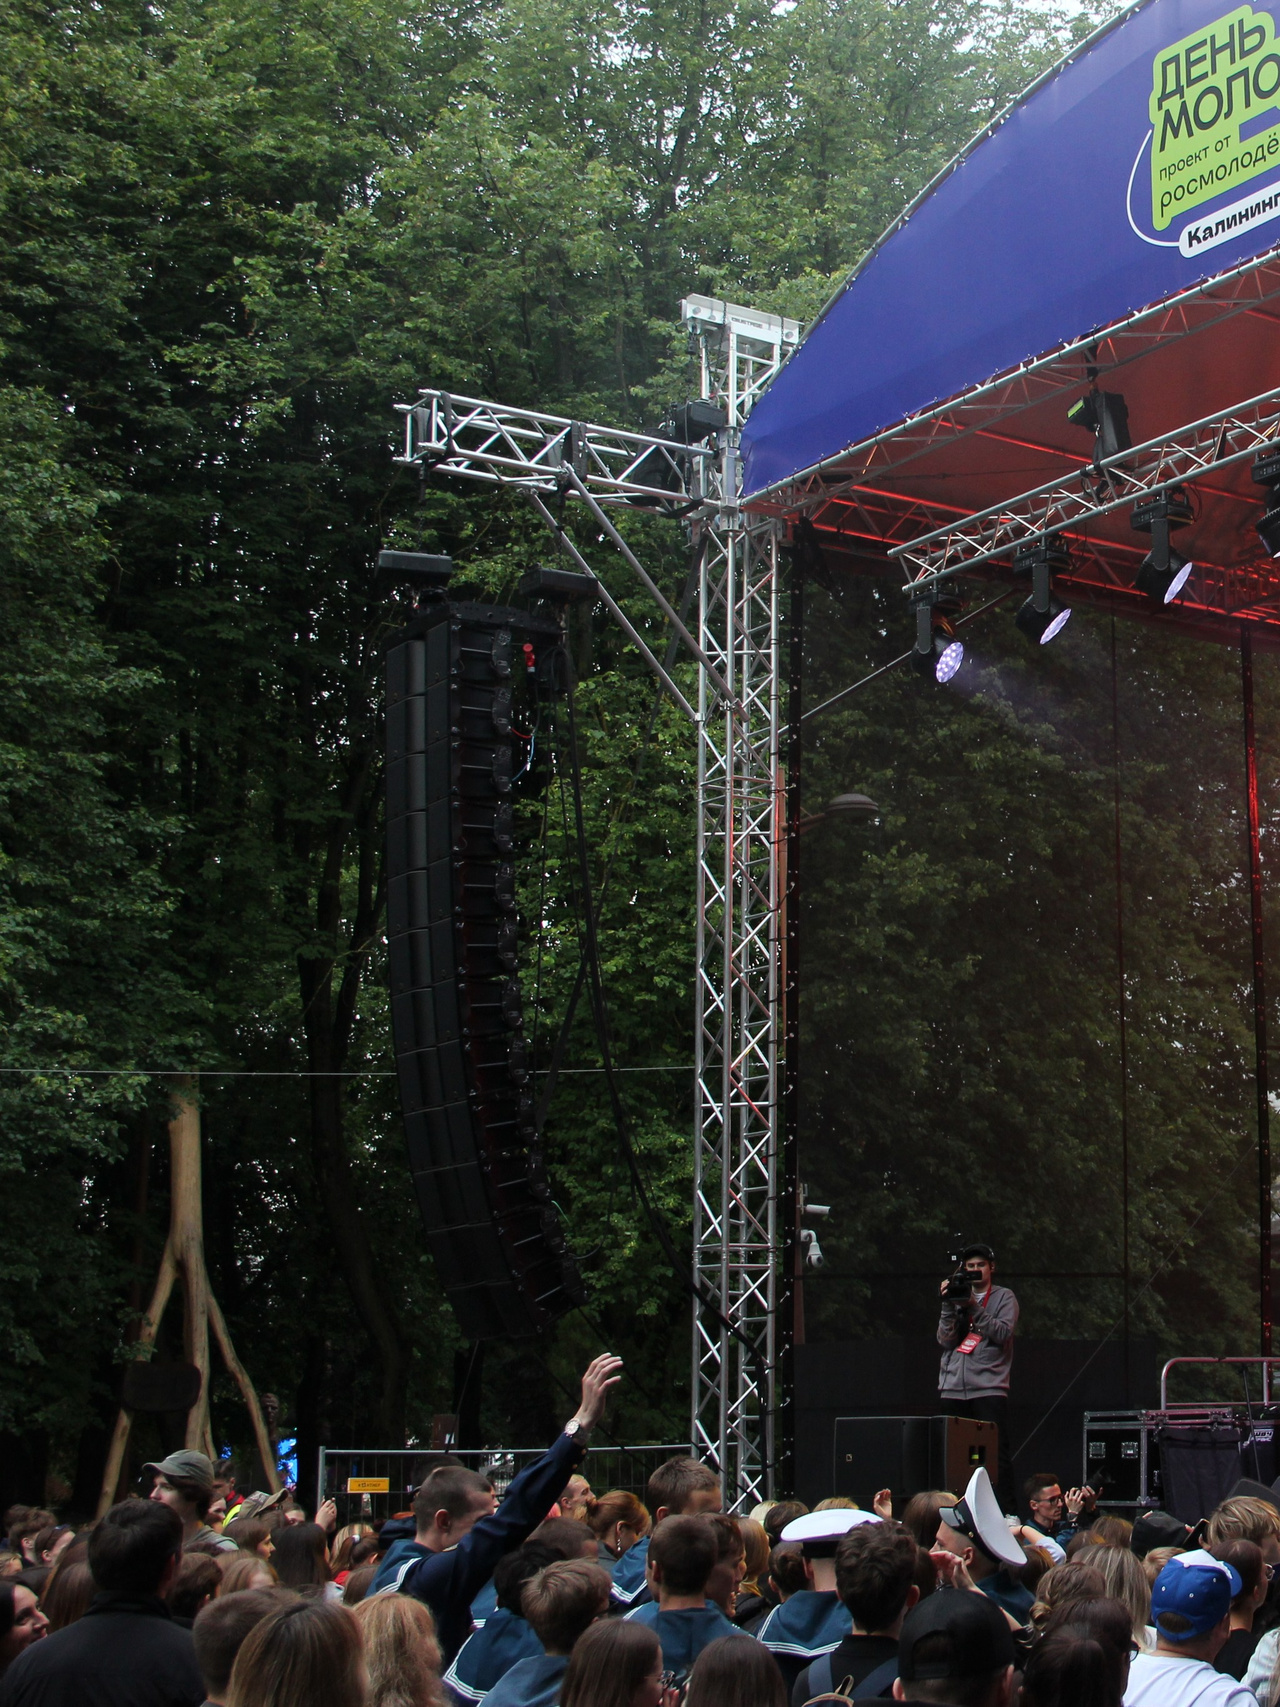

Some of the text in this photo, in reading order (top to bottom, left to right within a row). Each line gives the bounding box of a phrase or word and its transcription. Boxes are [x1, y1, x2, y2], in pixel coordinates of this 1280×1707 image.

[1158, 18, 1266, 111] ДЕНЬ
[1160, 135, 1232, 181] проект от
